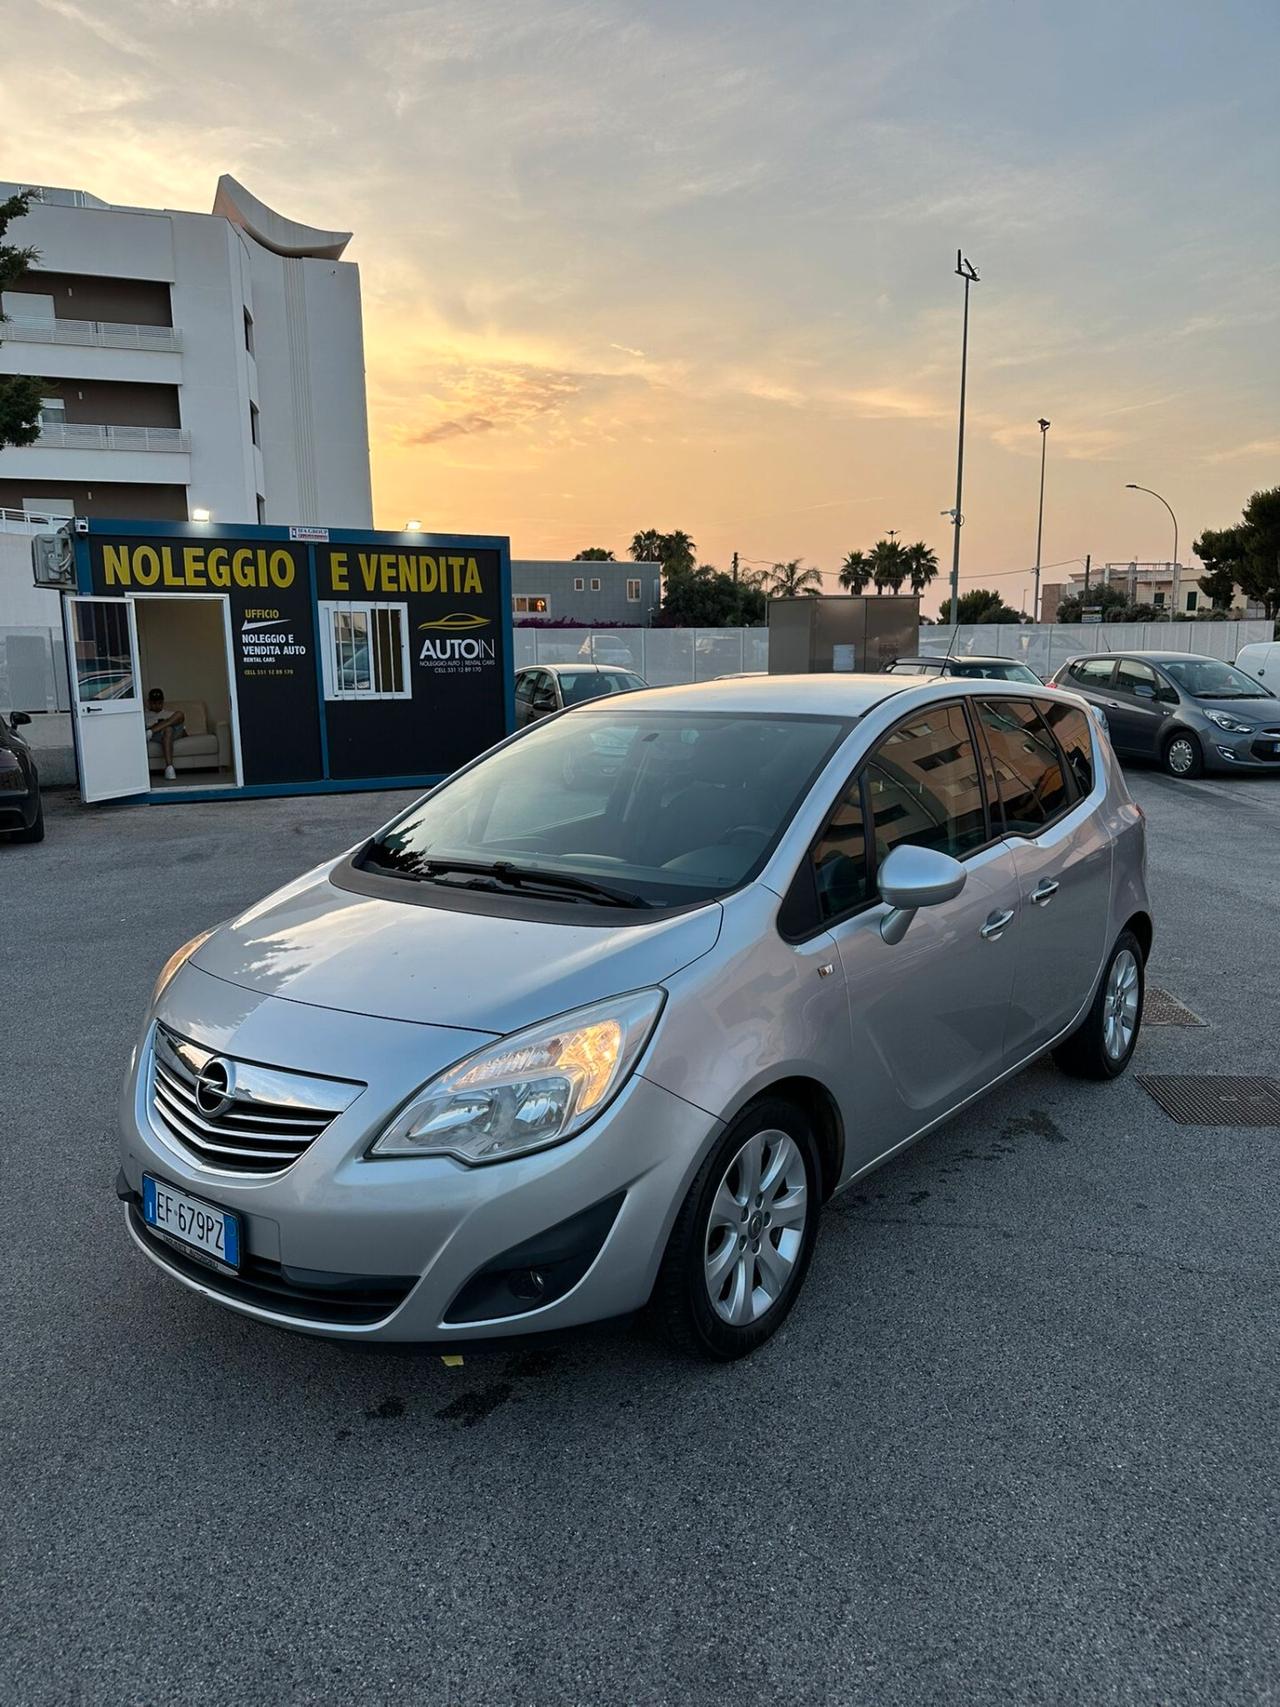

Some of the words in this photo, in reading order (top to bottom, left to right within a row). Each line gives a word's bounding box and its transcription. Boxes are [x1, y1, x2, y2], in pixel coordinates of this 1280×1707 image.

[102, 545, 295, 588] NOLEGGIO
[330, 552, 349, 591] E
[358, 553, 483, 593] VENDITA
[245, 609, 279, 618] UFFICIO
[242, 634, 286, 643] NOLEGGIO
[288, 634, 294, 643] E
[242, 646, 281, 655] VENDITA
[283, 646, 306, 655] AUTO
